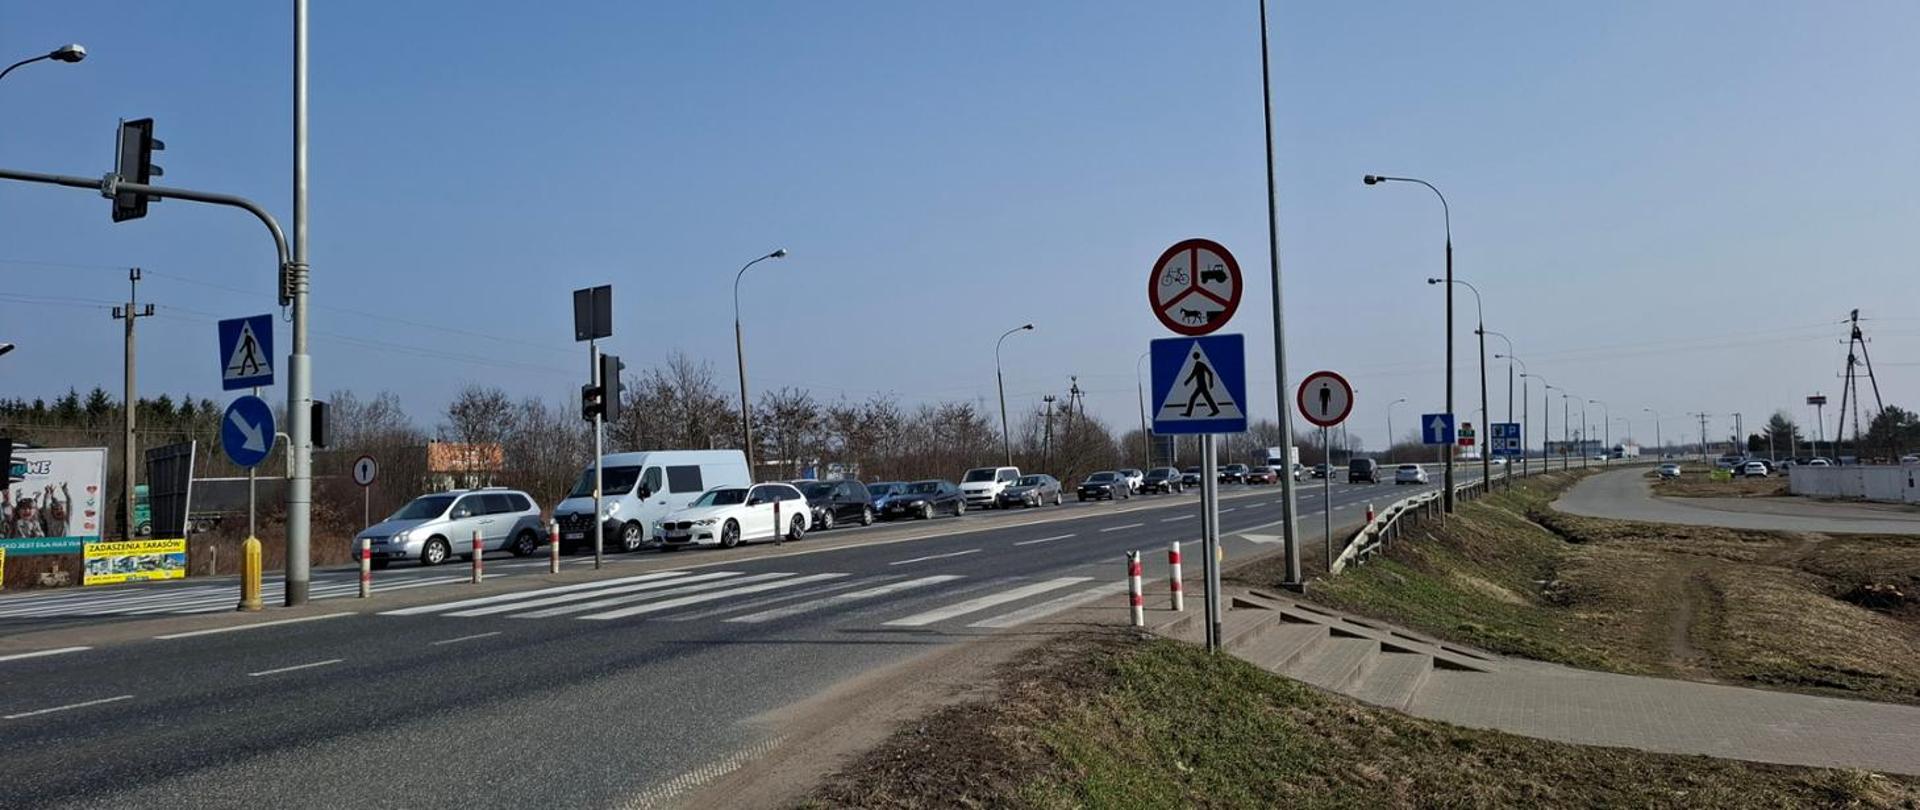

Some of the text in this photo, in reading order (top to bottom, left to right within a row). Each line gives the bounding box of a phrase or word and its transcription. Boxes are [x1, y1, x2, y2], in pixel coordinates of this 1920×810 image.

[1508, 425, 1517, 436] P
[90, 538, 180, 553] ZADASZENIA TARASÓW
